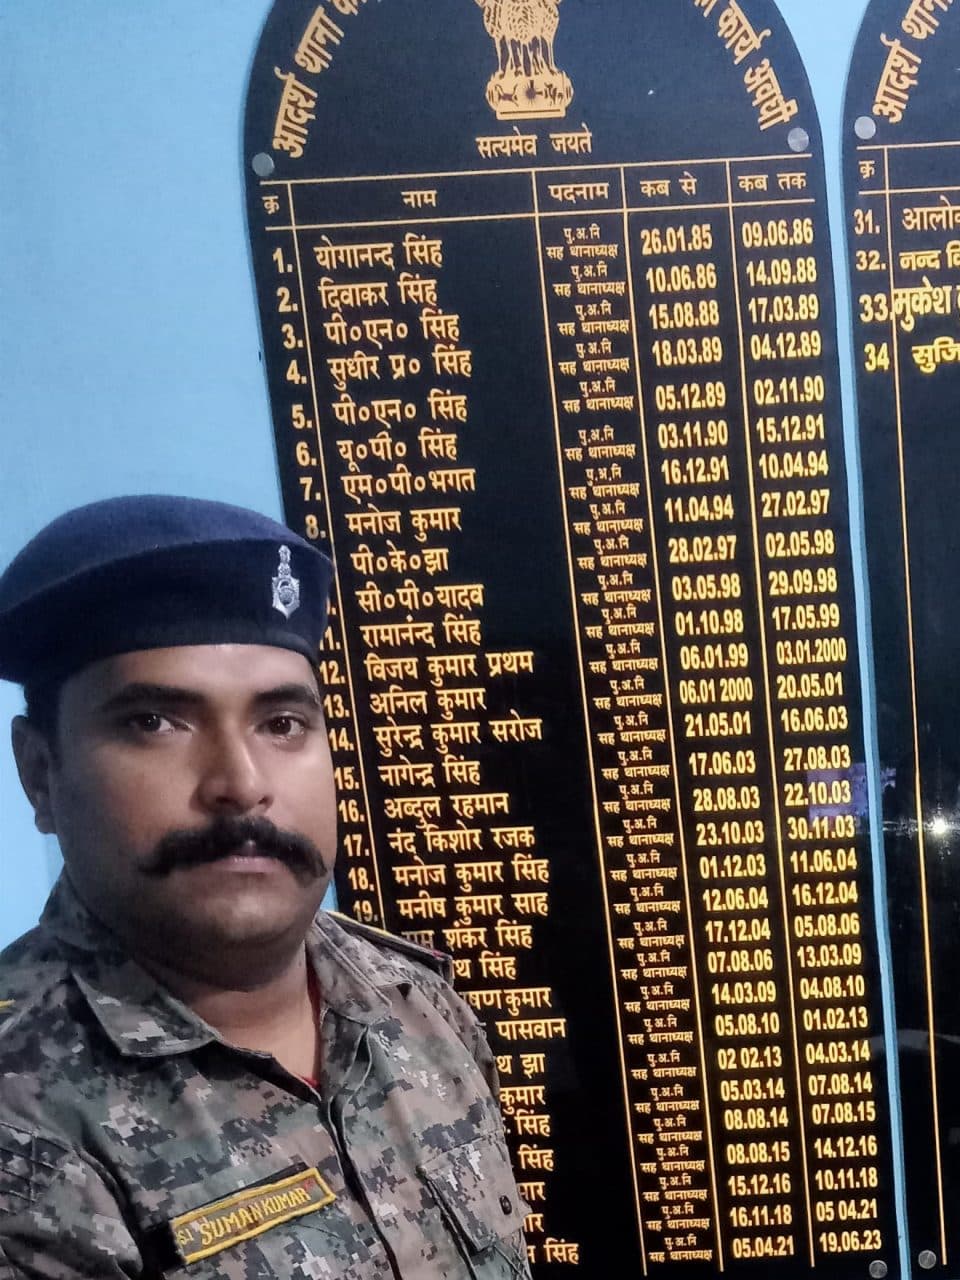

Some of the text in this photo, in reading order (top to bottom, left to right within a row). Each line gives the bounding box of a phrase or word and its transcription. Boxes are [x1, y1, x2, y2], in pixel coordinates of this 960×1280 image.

[273, 67, 317, 157] आदर्श
[295, 6, 344, 73] थाना
[873, 33, 921, 123] आदर्श
[476, 123, 592, 158] सत्यमेव जयते
[738, 173, 806, 192] कब तक
[859, 161, 874, 178] क्र
[548, 183, 609, 203] पदनाम
[640, 171, 697, 197] कब से
[263, 196, 279, 214] क्र
[402, 190, 437, 207] नाम
[742, 218, 813, 248] 09.06.86
[854, 209, 880, 234] 31.
[273, 233, 442, 273] 1. योगानन्द सिंह
[641, 224, 712, 255] 26.01.85
[546, 247, 563, 260] सह
[856, 250, 886, 270] 32.
[899, 250, 941, 270] नन्द
[646, 263, 716, 292] 10.06.86
[747, 257, 816, 286] 14.09.88
[277, 272, 437, 312] 2. दिवाकर सिंह
[859, 294, 893, 322] 33.
[895, 275, 953, 331] मुकेश
[652, 336, 722, 366] 18.03.89
[751, 331, 821, 360] 04.12.89
[662, 456, 729, 484] 16.12.91
[759, 450, 828, 478] 10.04.94
[665, 495, 734, 522] 11.04.94
[762, 489, 829, 517] 27.02.97
[345, 503, 461, 542] मनोज कुमार
[672, 573, 740, 600] 03.05.98
[769, 568, 837, 595] 29.09.98
[442, 613, 481, 645] सिंह
[364, 653, 418, 681] विजय
[426, 655, 477, 687] कुमार
[485, 651, 533, 676] प्रथम
[777, 672, 842, 699] 20.05.01
[324, 685, 486, 720] 13. अनिल कुमार
[685, 711, 751, 737] 21.05.01
[781, 706, 848, 732] 16.06.03
[329, 709, 542, 759] 14. सुरेन्द्र कुमार सरोज
[378, 754, 480, 787] नागेन्द्र सिंह
[602, 768, 619, 780] सह
[693, 786, 760, 811] 28.08.03
[785, 780, 851, 806] 22.10.03
[339, 793, 509, 822] 16. रहमान
[344, 821, 534, 856] 17. नंद किशोर रजक
[349, 853, 549, 892] 18. मनोज कुमार सिंह
[703, 887, 768, 911] 12.06.04
[792, 881, 858, 905] 16.12.04
[397, 890, 446, 919] मनीष
[454, 895, 503, 927] कुमार
[511, 893, 548, 916] साह
[442, 921, 488, 951] शंकर
[495, 919, 532, 948] सिंह
[706, 918, 770, 942] 17.12.04
[795, 913, 859, 937] 05.08.06
[479, 951, 516, 979] सिंह
[712, 981, 776, 1004] 14.03.09
[800, 975, 864, 999] 04.08.10
[504, 987, 551, 1016] कुमार
[495, 1019, 566, 1040] पासवान
[520, 1054, 545, 1078] झा
[721, 1078, 785, 1101] 05.03.14
[809, 1072, 872, 1095] 07.08.14
[499, 1086, 545, 1114] कुमार
[812, 1101, 875, 1124] 07.08.15
[514, 1109, 550, 1136] सिंह
[725, 1107, 788, 1130] 08.08.14
[728, 1173, 791, 1195] 15.12.16
[815, 1167, 877, 1190] 10.11.18
[200, 1202, 264, 1246] SUMAN
[262, 1187, 312, 1216] KUMAR
[730, 1205, 792, 1227] 16.11.18
[543, 1238, 578, 1264] सिंह
[733, 1236, 794, 1258] 05.04.21
[820, 1230, 881, 1252] 19.06.23
[649, 1252, 665, 1262] सह
